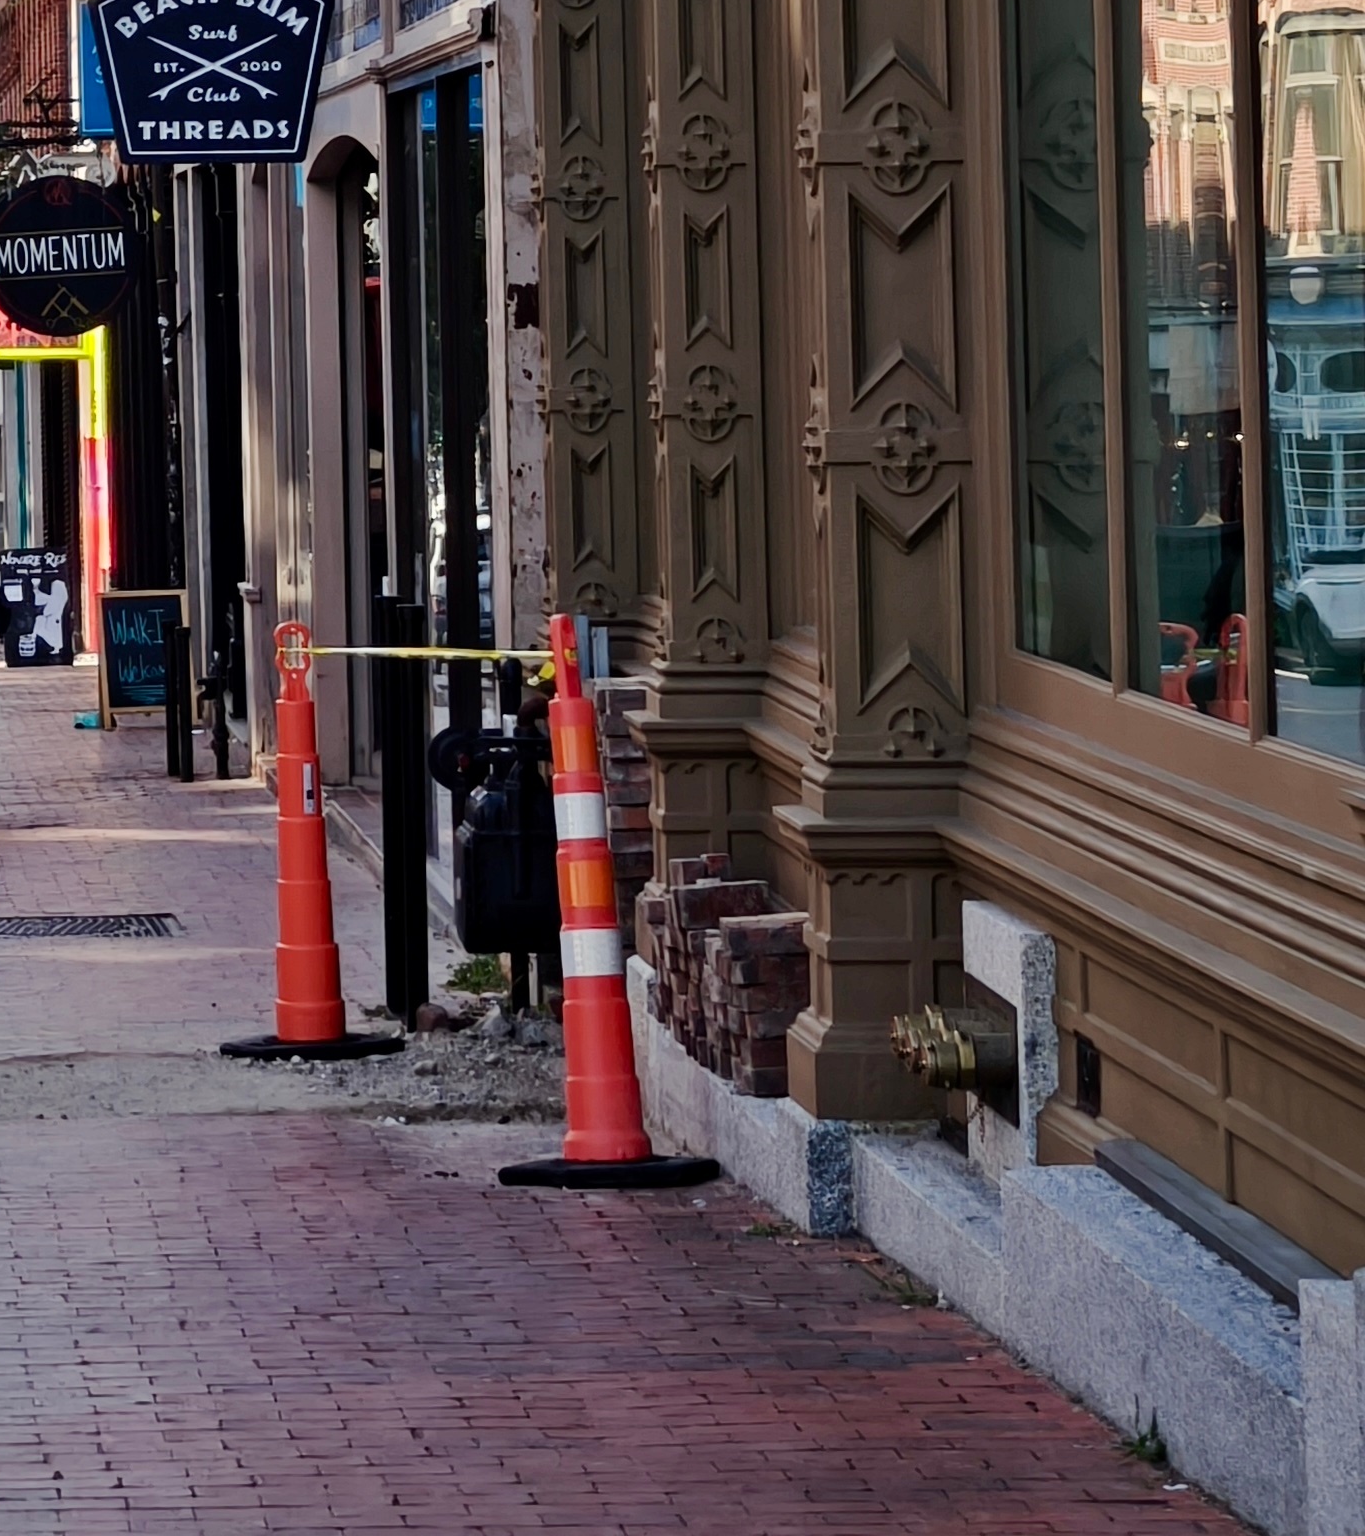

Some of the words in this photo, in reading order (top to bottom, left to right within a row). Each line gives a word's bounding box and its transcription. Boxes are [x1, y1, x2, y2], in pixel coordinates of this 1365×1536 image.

[187, 24, 238, 42] Surf
[153, 62, 186, 73] EST.
[240, 60, 282, 72] 2020
[187, 86, 241, 103] Club
[138, 119, 290, 141] THREADS
[108, 608, 164, 646] Walk-I
